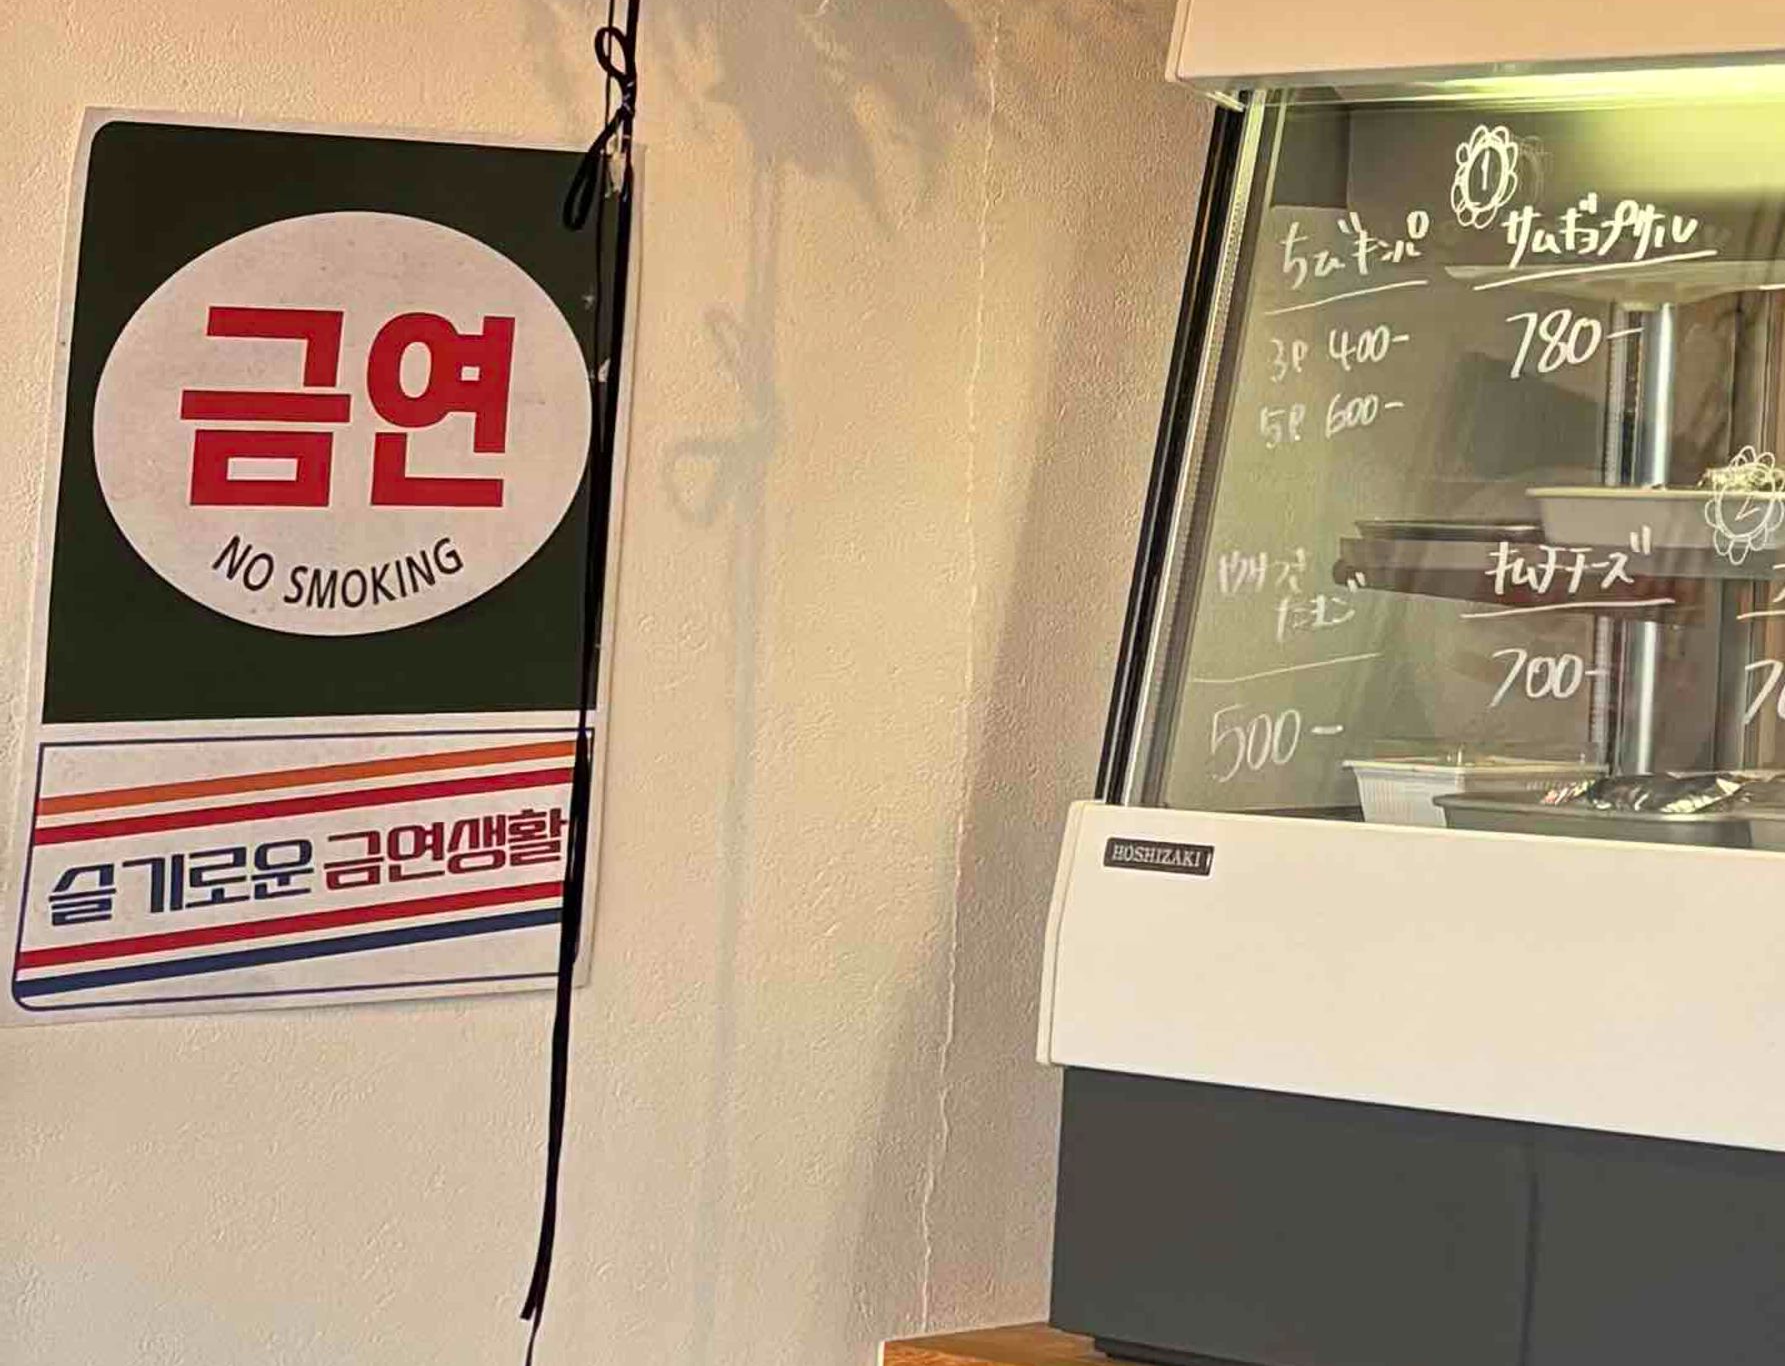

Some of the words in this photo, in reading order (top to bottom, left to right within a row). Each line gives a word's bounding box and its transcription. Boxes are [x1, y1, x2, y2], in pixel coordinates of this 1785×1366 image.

[181, 306, 516, 509] 금연
[211, 533, 274, 593] NO
[284, 536, 466, 609] SMOKING
[1484, 525, 1653, 596] キムチチーズ
[47, 836, 316, 927] 슬기로운
[322, 805, 568, 892] 금연생활
[1111, 843, 1200, 868] HOSHIZAKI
